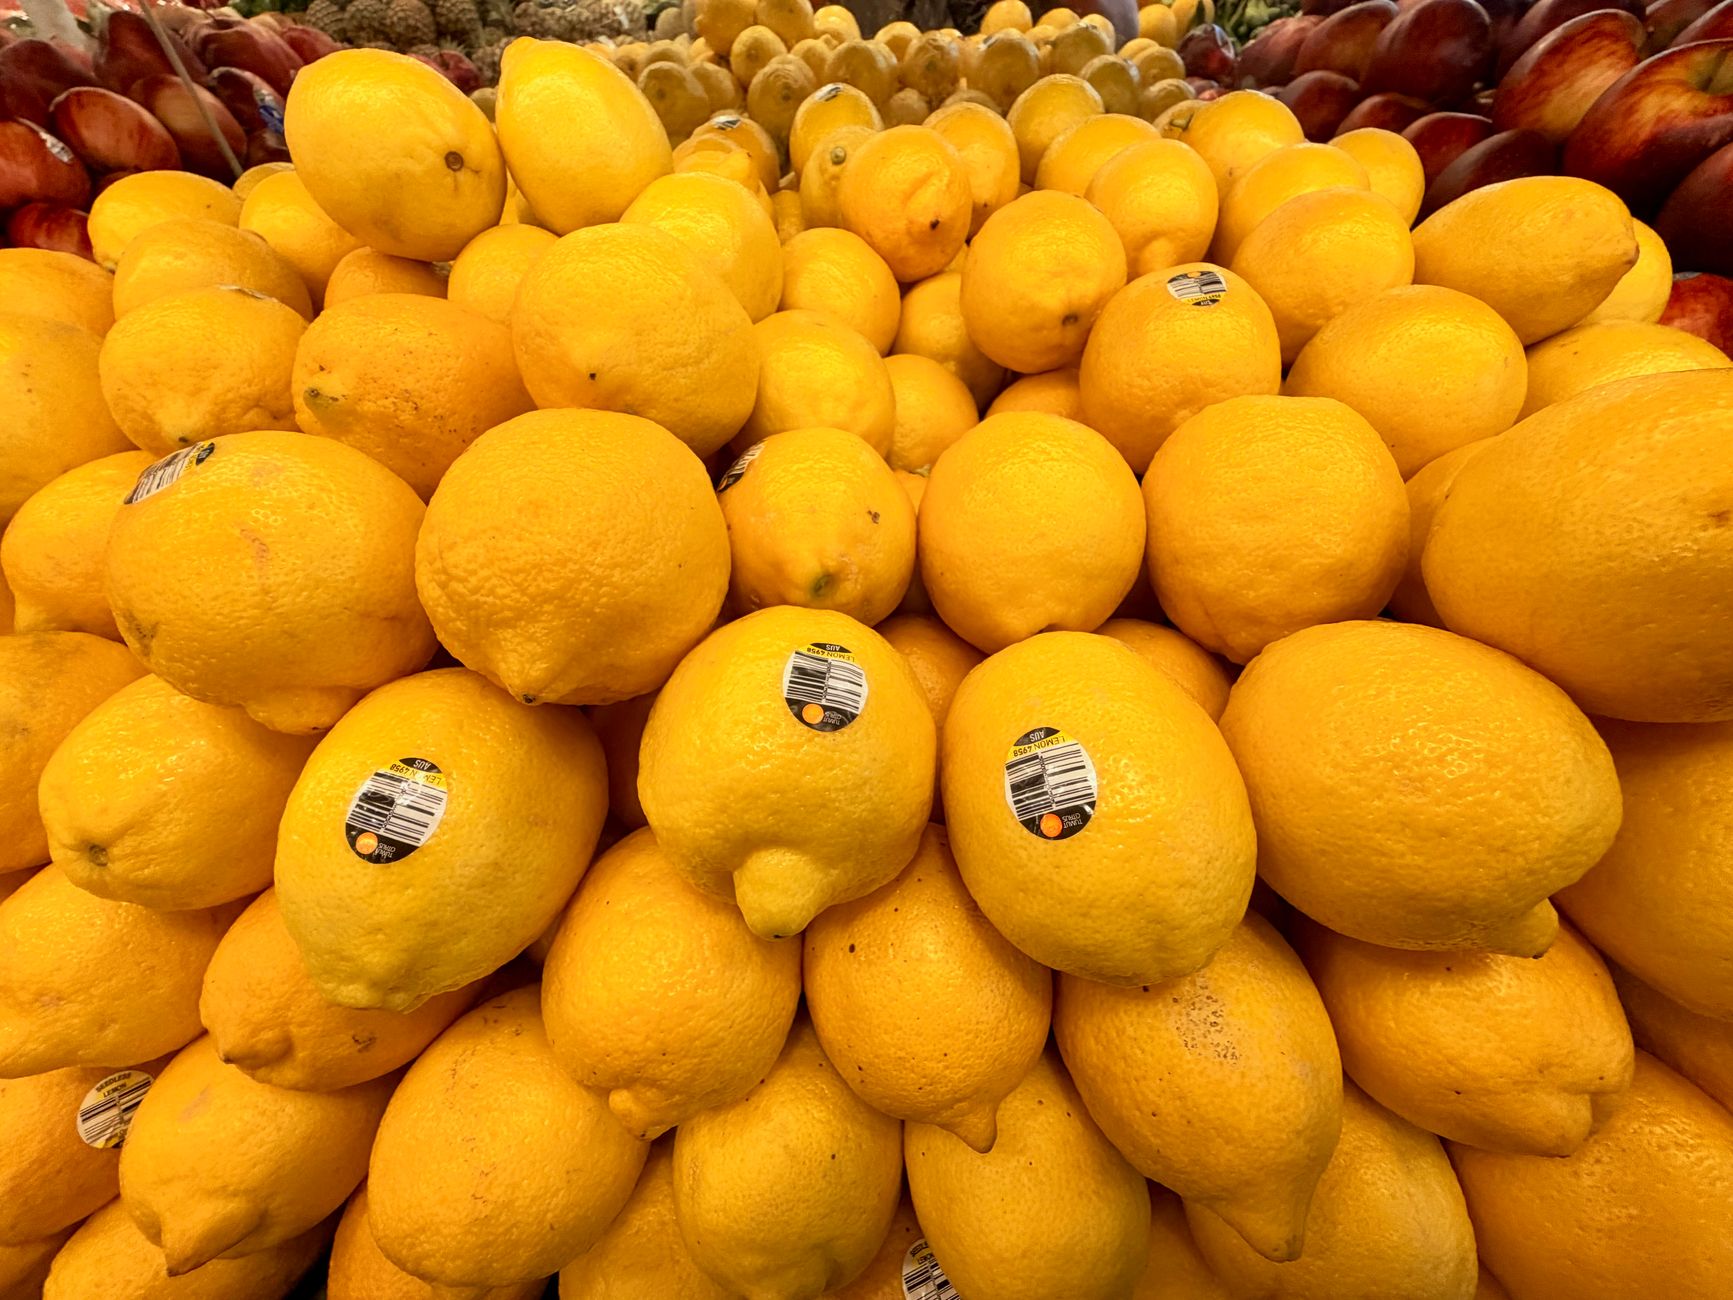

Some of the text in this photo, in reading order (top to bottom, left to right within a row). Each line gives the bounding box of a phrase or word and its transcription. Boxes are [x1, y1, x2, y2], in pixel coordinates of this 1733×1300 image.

[825, 644, 841, 652] AUS
[806, 647, 855, 662] LEMON 4958
[1029, 730, 1045, 742] AUS
[1012, 736, 1066, 757] LEMON 4958
[412, 759, 432, 770] AUS
[389, 763, 442, 785] LEMN 4958
[1061, 812, 1081, 822] CITRUS
[1063, 819, 1083, 829] TUMUT
